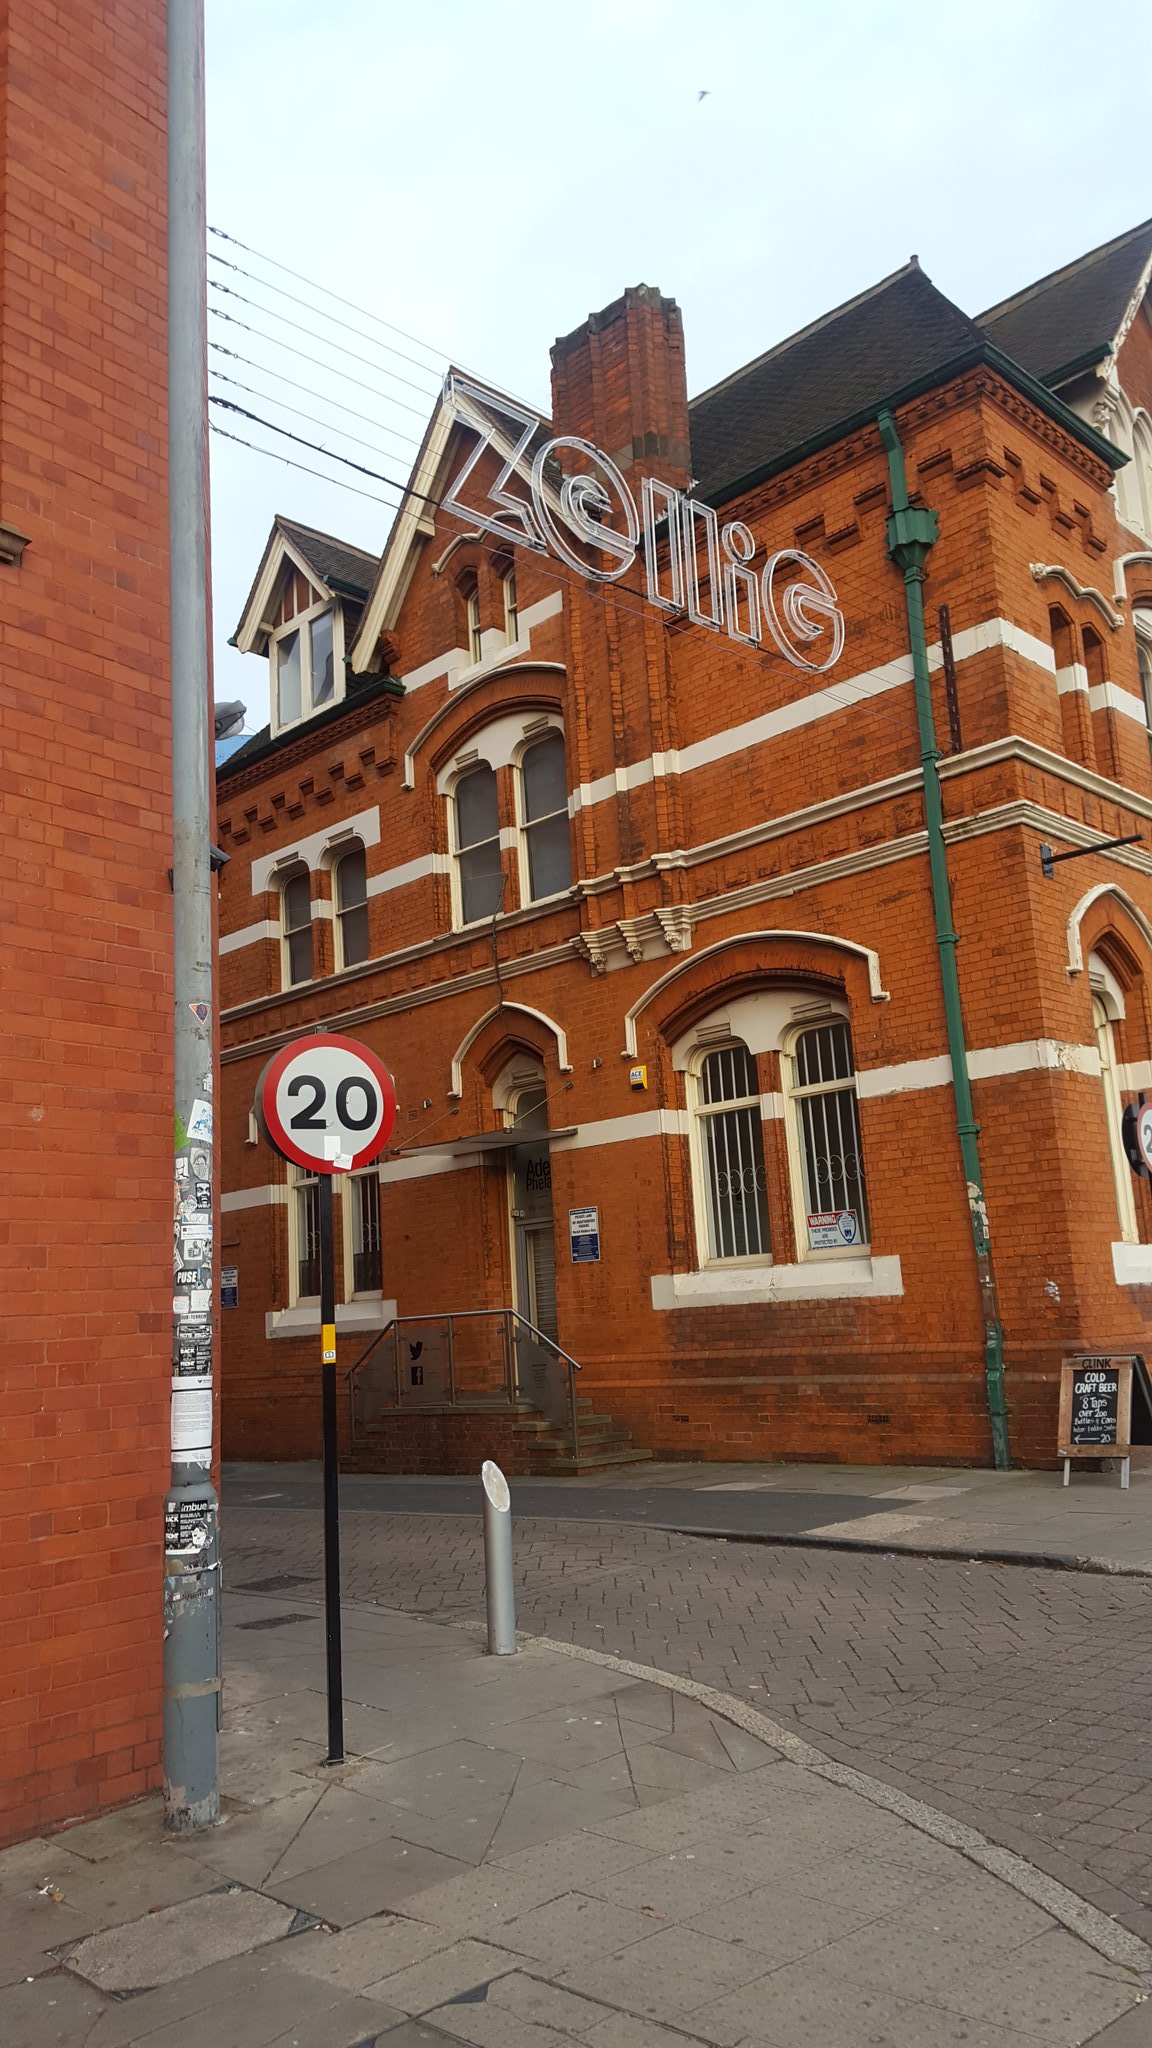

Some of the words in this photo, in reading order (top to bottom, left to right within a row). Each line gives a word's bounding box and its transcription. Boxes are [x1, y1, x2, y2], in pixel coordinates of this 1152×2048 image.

[287, 1074, 378, 1131] 20
[809, 1214, 837, 1226] WARNING
[1082, 1358, 1112, 1369] CLINK
[1084, 1372, 1106, 1383] COLD
[1074, 1383, 1097, 1394] CRAFT
[1098, 1382, 1117, 1393] BEER
[1082, 1397, 1089, 1409] 8
[1090, 1397, 1108, 1409] Taps
[180, 1502, 208, 1512] imbue
